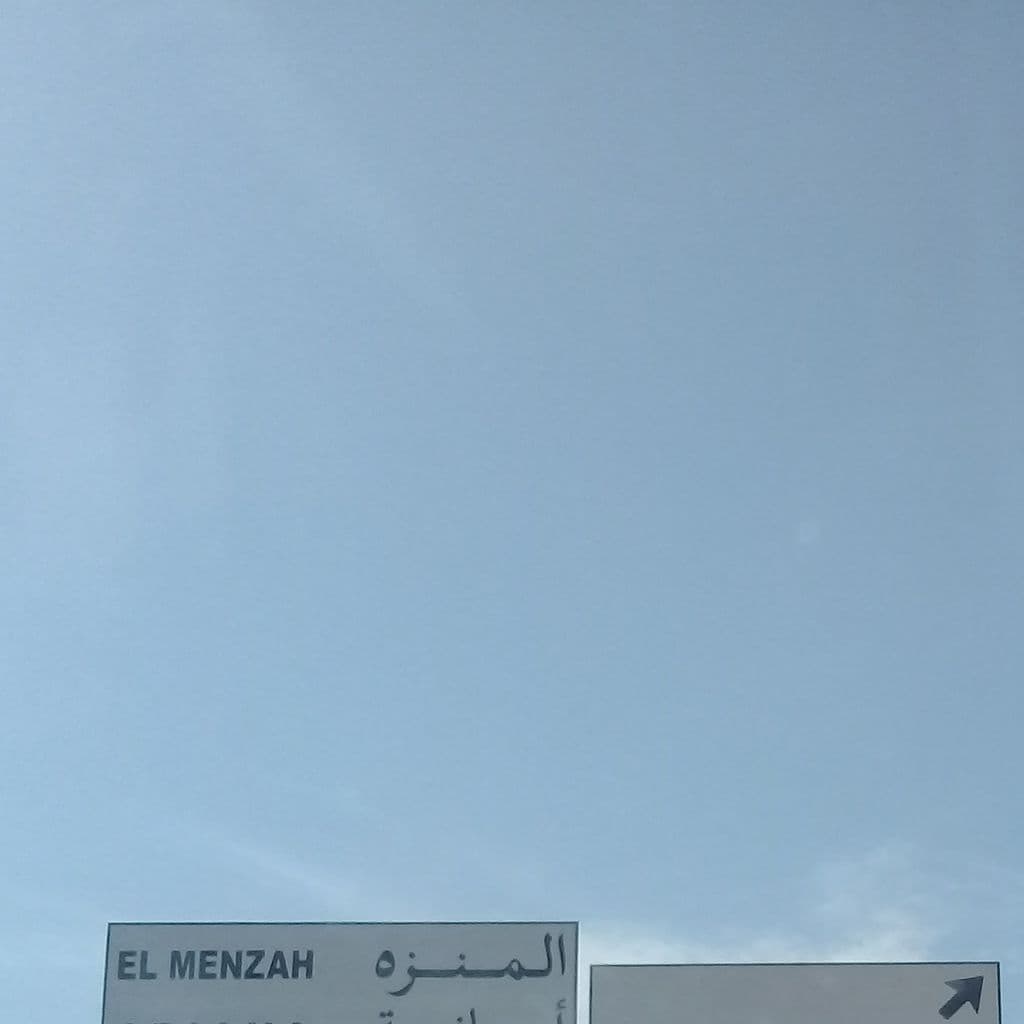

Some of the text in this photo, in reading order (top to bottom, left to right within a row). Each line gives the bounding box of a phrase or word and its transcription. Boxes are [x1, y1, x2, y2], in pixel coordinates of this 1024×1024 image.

[117, 949, 314, 981] EL MENZAH
[375, 933, 566, 997] المنزه
